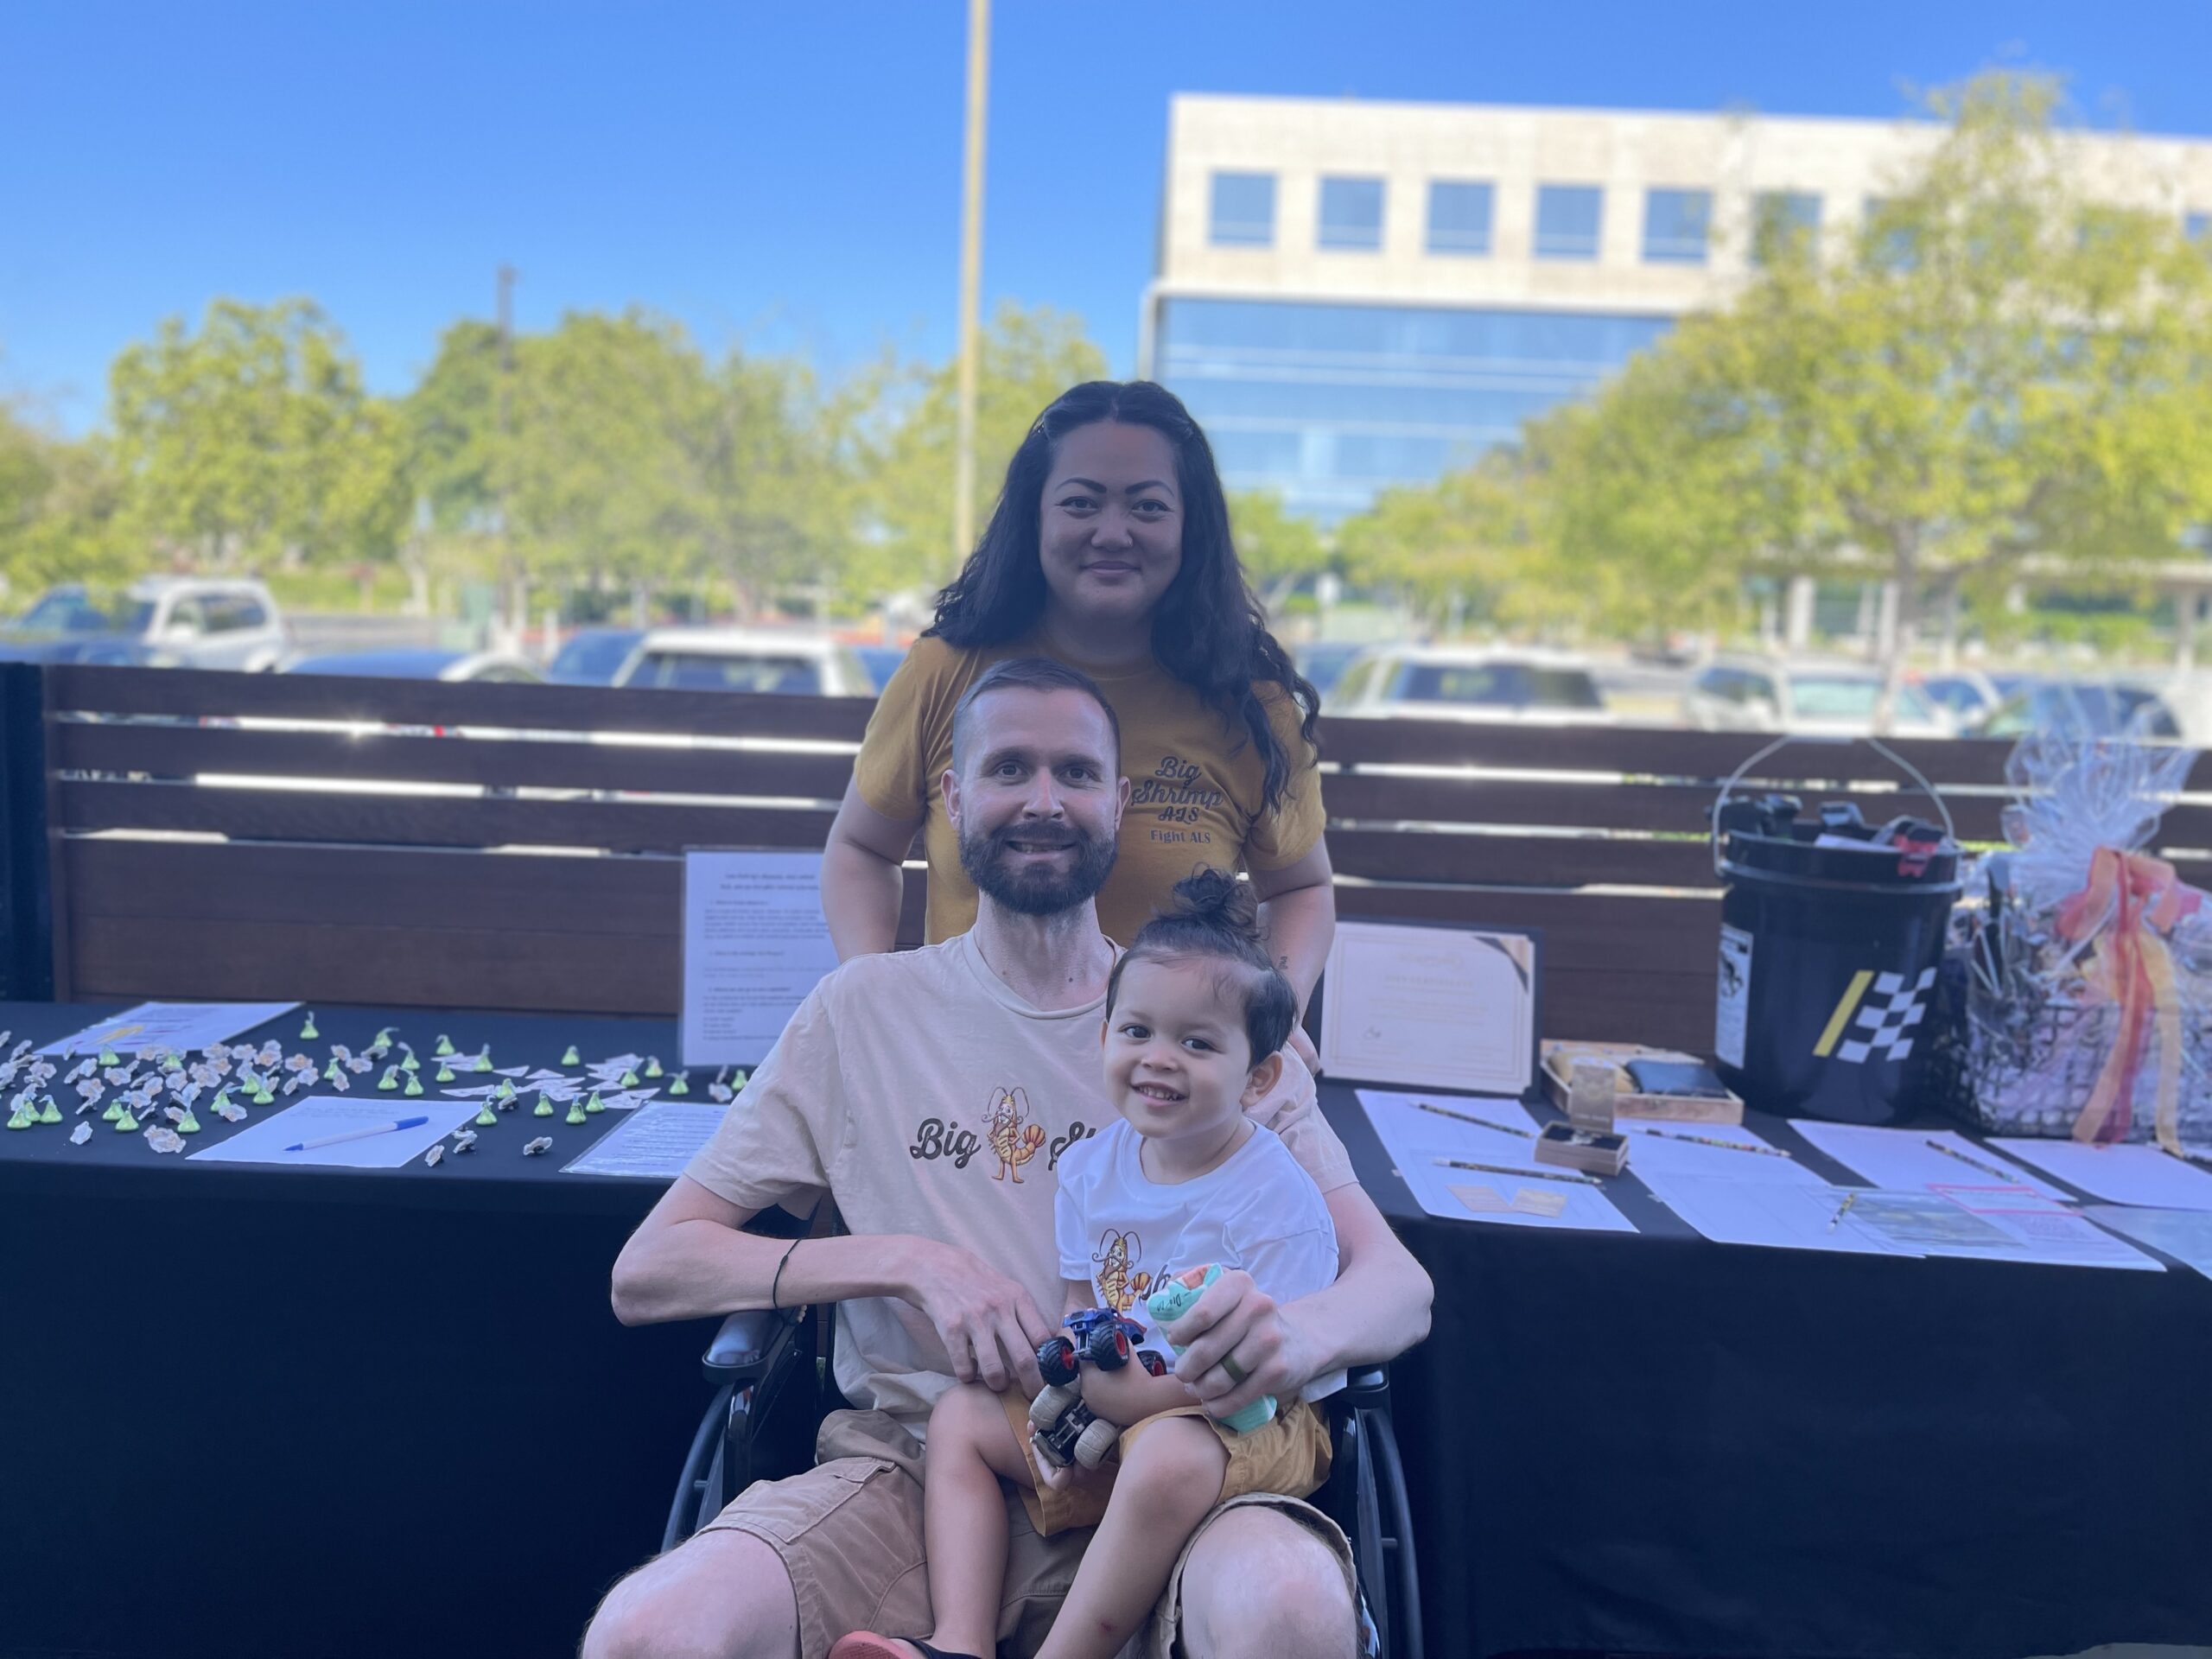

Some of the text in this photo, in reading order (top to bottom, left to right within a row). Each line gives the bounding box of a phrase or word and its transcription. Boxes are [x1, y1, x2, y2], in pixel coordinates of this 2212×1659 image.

[1154, 755, 1202, 786] Big
[1130, 779, 1223, 810] Shrimp
[1158, 805, 1199, 824] ALS
[1150, 830, 1211, 844] Fight ALS
[909, 1117, 982, 1169] Big
